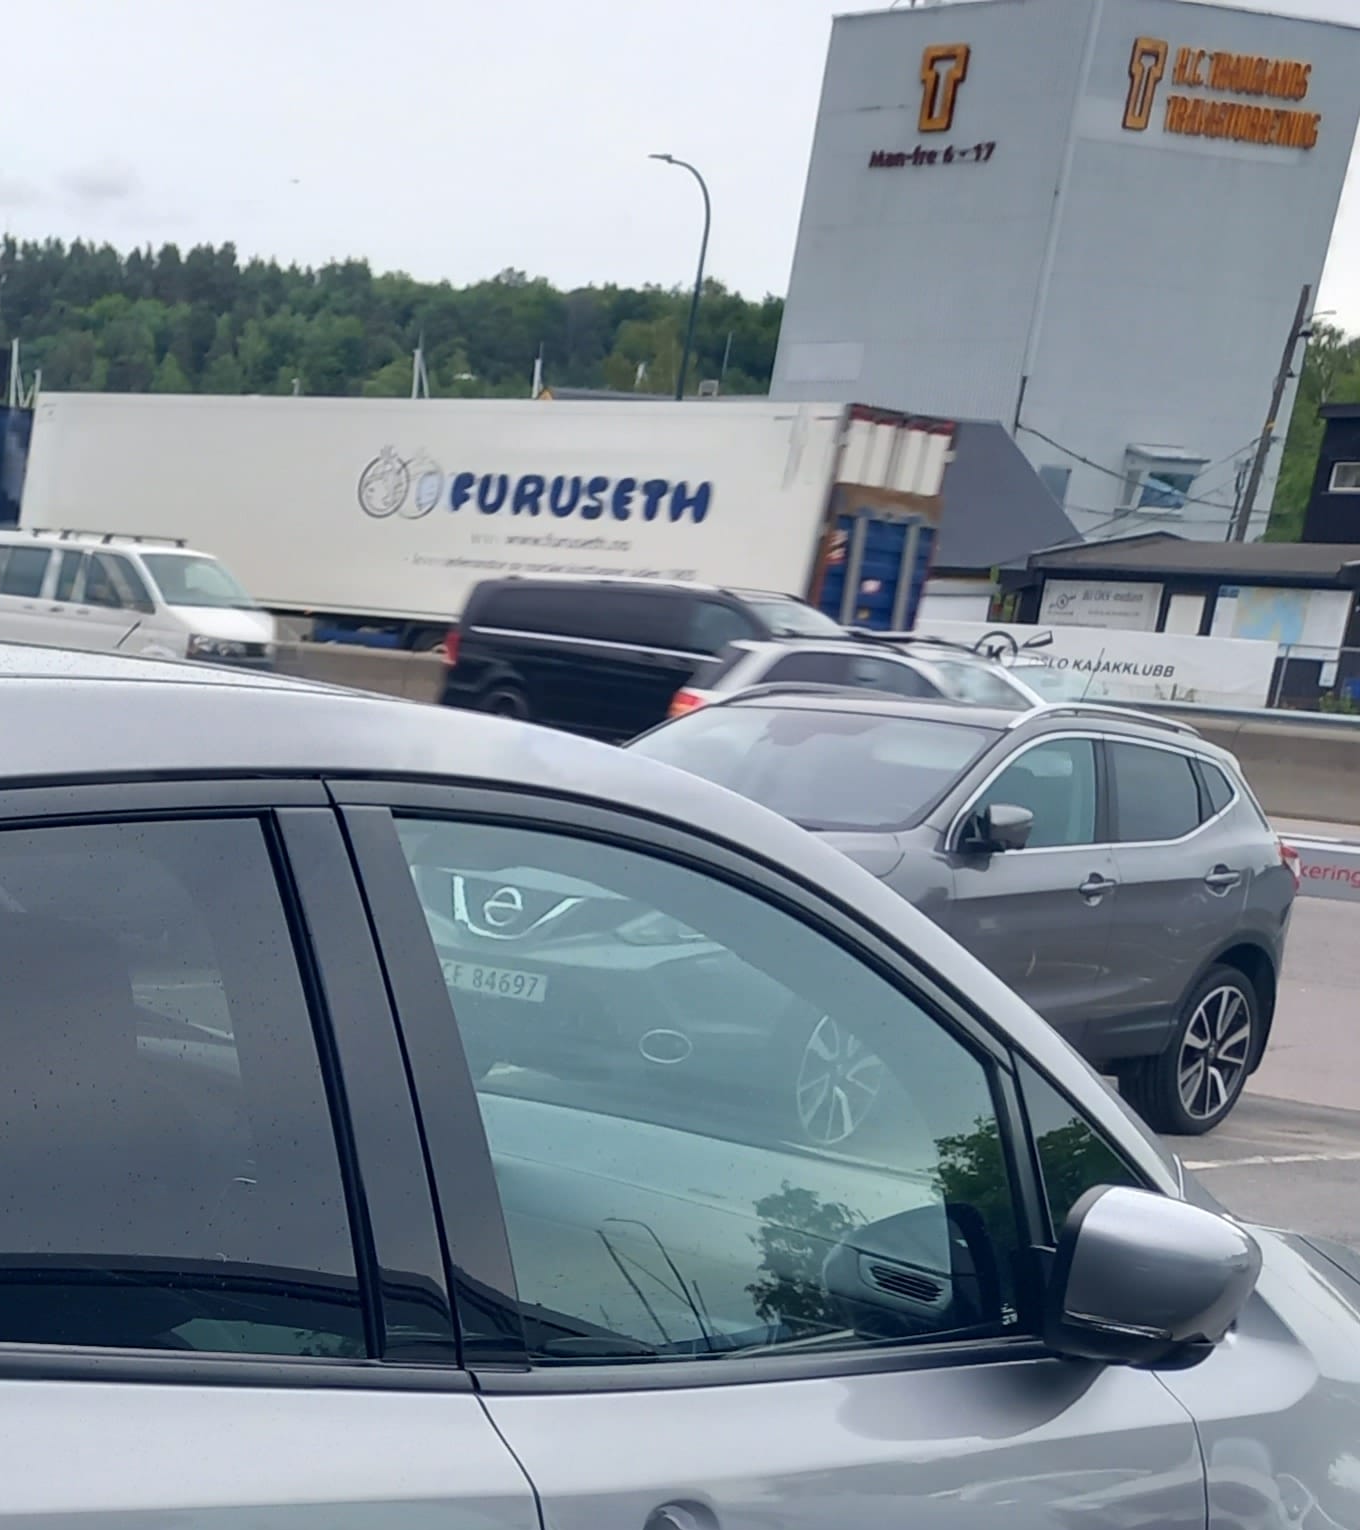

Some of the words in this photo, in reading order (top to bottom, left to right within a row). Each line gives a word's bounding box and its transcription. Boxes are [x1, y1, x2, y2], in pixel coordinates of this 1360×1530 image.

[973, 141, 996, 163] 17
[449, 471, 713, 524] FURUSETH
[1072, 659, 1175, 678] KAJAKKLUBB
[472, 968, 539, 997] 84697
